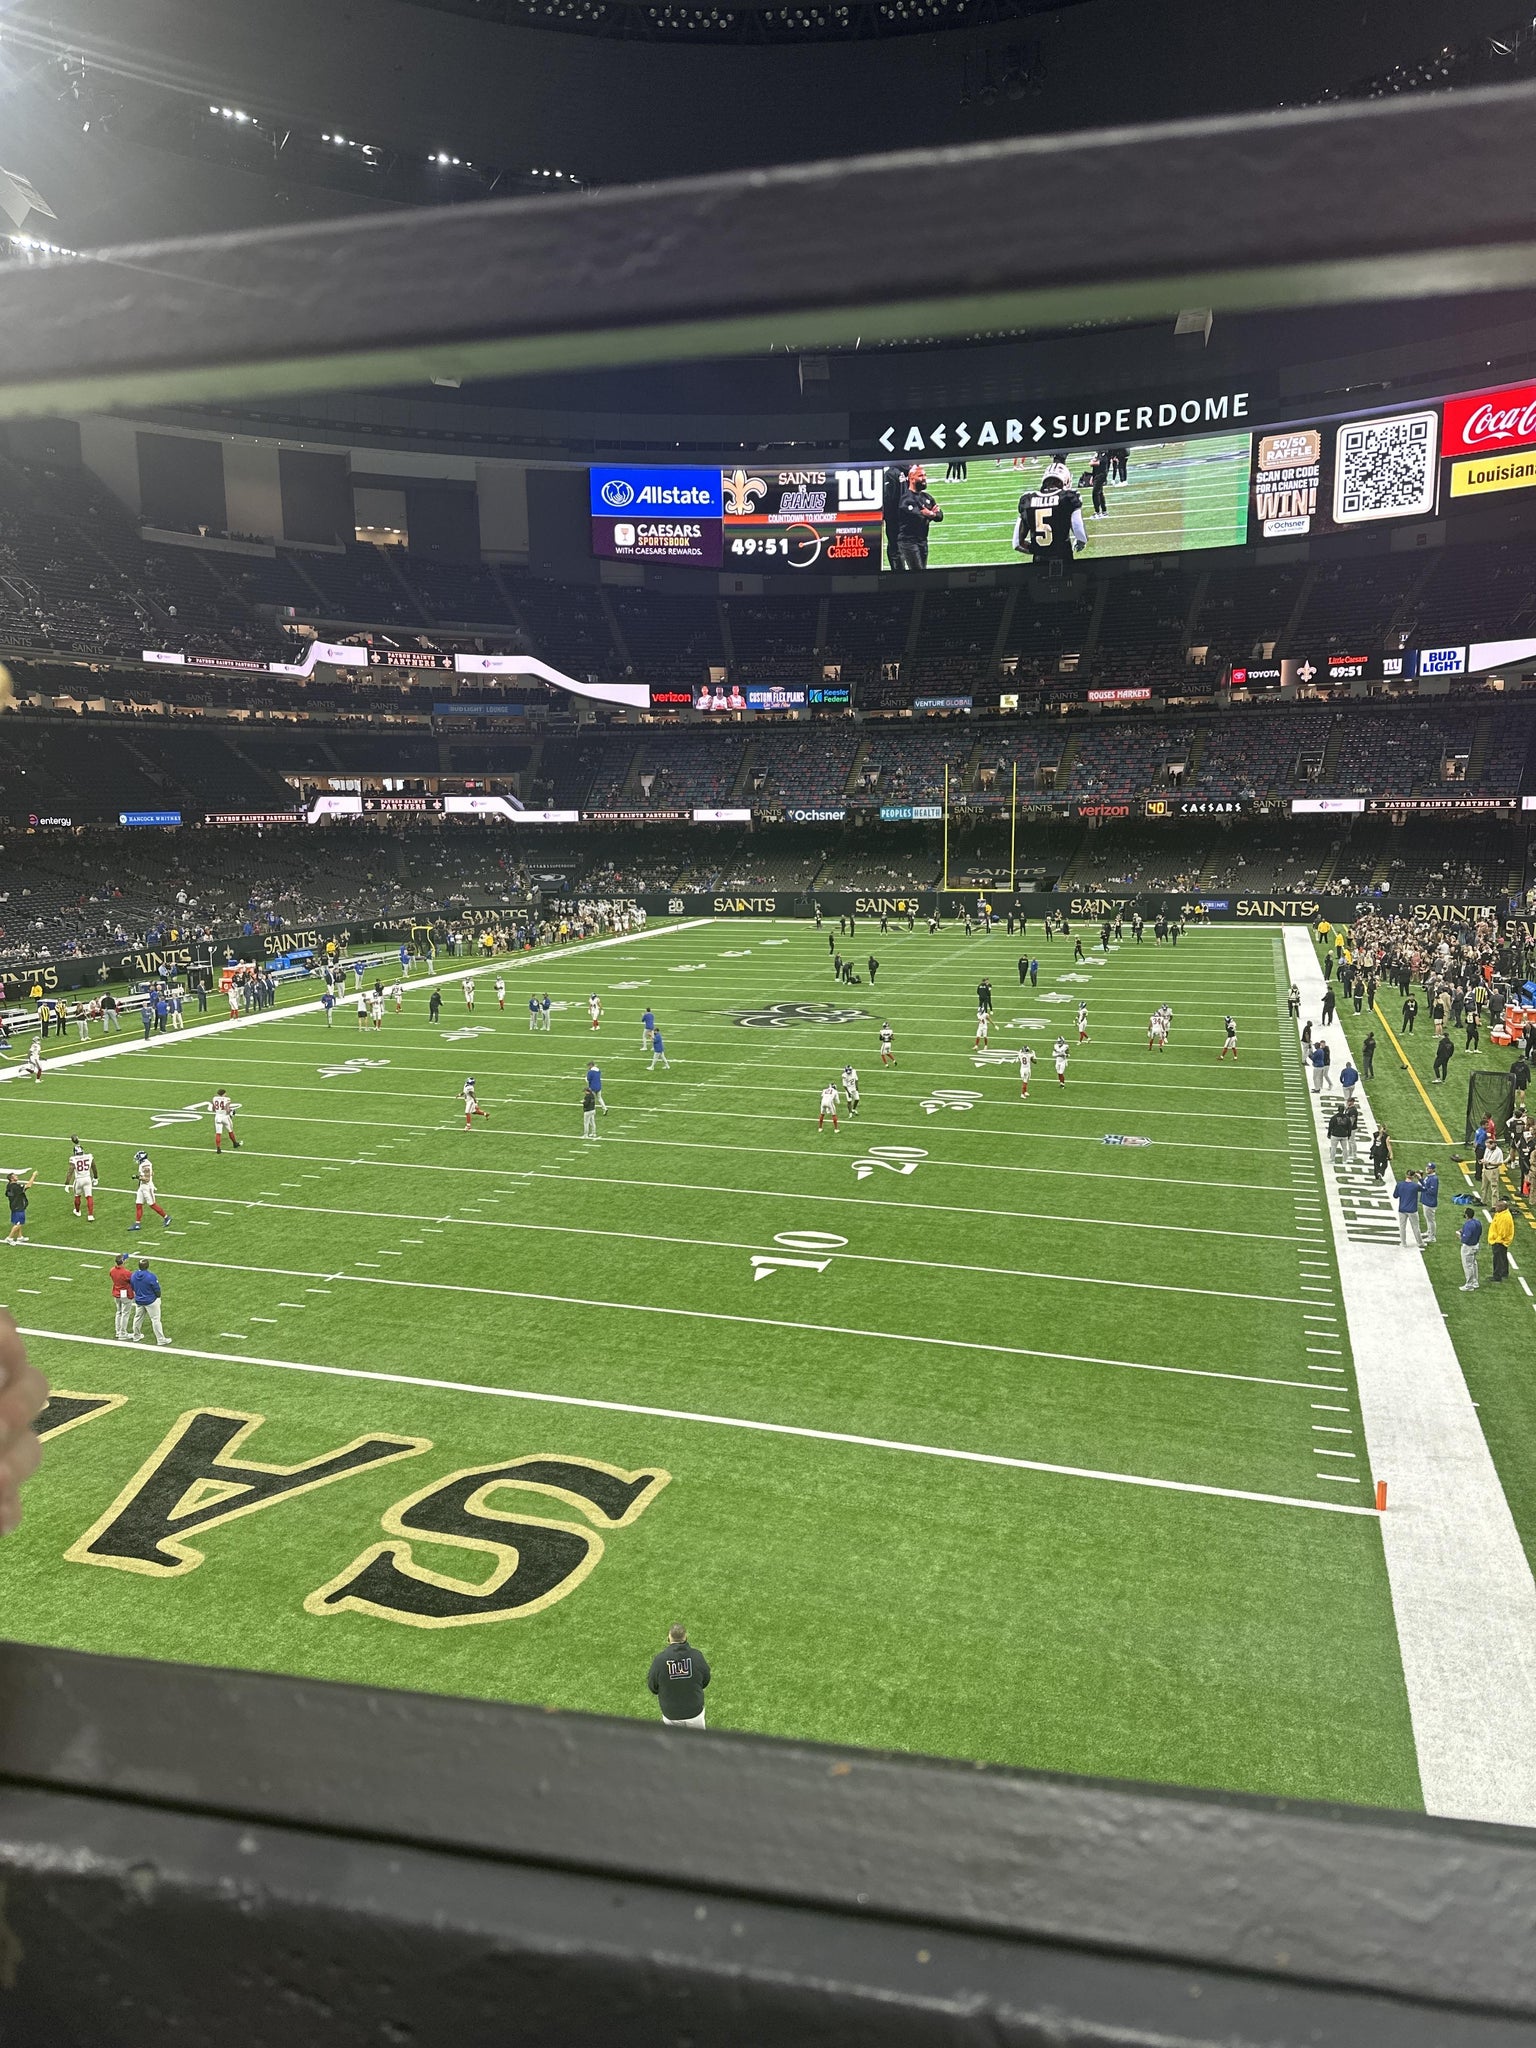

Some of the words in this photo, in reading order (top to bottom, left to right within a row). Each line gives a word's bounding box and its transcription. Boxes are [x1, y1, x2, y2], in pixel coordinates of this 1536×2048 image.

[879, 415, 1047, 452] CAESARS
[1052, 392, 1250, 439] SUPERDOME
[1273, 436, 1307, 450] 50/50
[1266, 445, 1313, 461] RAFFLE
[779, 471, 826, 485] SAINTS
[1256, 470, 1281, 483] SCAN
[1282, 468, 1295, 480] QR
[1296, 465, 1320, 478] CODE
[1468, 464, 1536, 485] Louisian
[1256, 482, 1271, 494] FOR
[1272, 482, 1277, 492] A
[1278, 479, 1308, 491] CHANCE
[1309, 477, 1319, 487] TO
[636, 485, 710, 504] Allstate
[779, 491, 827, 511] GIANTS
[1256, 487, 1317, 520] WIN!
[768, 514, 805, 523] COUNTDOWN
[806, 514, 813, 522] TO
[813, 513, 837, 522] KICKOFF
[637, 524, 702, 537] CAESARS
[1035, 507, 1053, 547] 5
[1274, 520, 1305, 530] Ochsner
[638, 536, 690, 547] SPORTSBOOK
[731, 538, 789, 555] 49:51
[836, 535, 864, 547] Little
[635, 547, 667, 555] CAESARS
[828, 546, 869, 558] Caesars
[71, 642, 104, 655] SAINTS
[412, 653, 435, 661] SAINTS
[1328, 656, 1344, 664] Little
[1344, 655, 1368, 663] Caesars
[1429, 650, 1457, 662] BUD
[387, 658, 436, 667] PARTNERS
[1423, 660, 1462, 673] LIGHT
[1247, 669, 1280, 679] TOYOTA
[1329, 665, 1363, 678] 49:51
[652, 692, 691, 703] verizon
[749, 691, 772, 702] CUSTOM
[773, 691, 786, 702] FLEX
[787, 691, 805, 702] PLANS
[1088, 690, 1115, 700] ROUSES
[1116, 688, 1150, 699] MARKETS
[370, 702, 399, 710] SAINTS
[945, 698, 971, 706] GLOBAL
[954, 806, 984, 814] SAINTS
[1022, 804, 1053, 812] SAINTS
[1078, 804, 1129, 816] verizon
[1148, 801, 1165, 814] 40
[1181, 803, 1241, 812] CAESARS
[1253, 800, 1287, 808] SAINTS
[753, 808, 782, 816] SAINTS
[794, 809, 846, 821] Ochsner
[881, 808, 912, 818] PEOPLES
[914, 807, 940, 817] HEALTH
[40, 816, 71, 827] entergy
[966, 867, 1046, 876] SAINTS
[714, 898, 776, 912] SAINTS
[855, 898, 919, 913] SAINTS
[1071, 899, 1136, 914] SAINT
[1236, 900, 1313, 917] SAINTS
[264, 931, 318, 955] SAINTS
[1021, 1057, 1028, 1066] 8
[214, 1101, 225, 1111] 84
[919, 1089, 984, 1112] 30
[76, 1159, 90, 1172] 85
[851, 1146, 929, 1176] 20
[749, 1230, 849, 1274] 10
